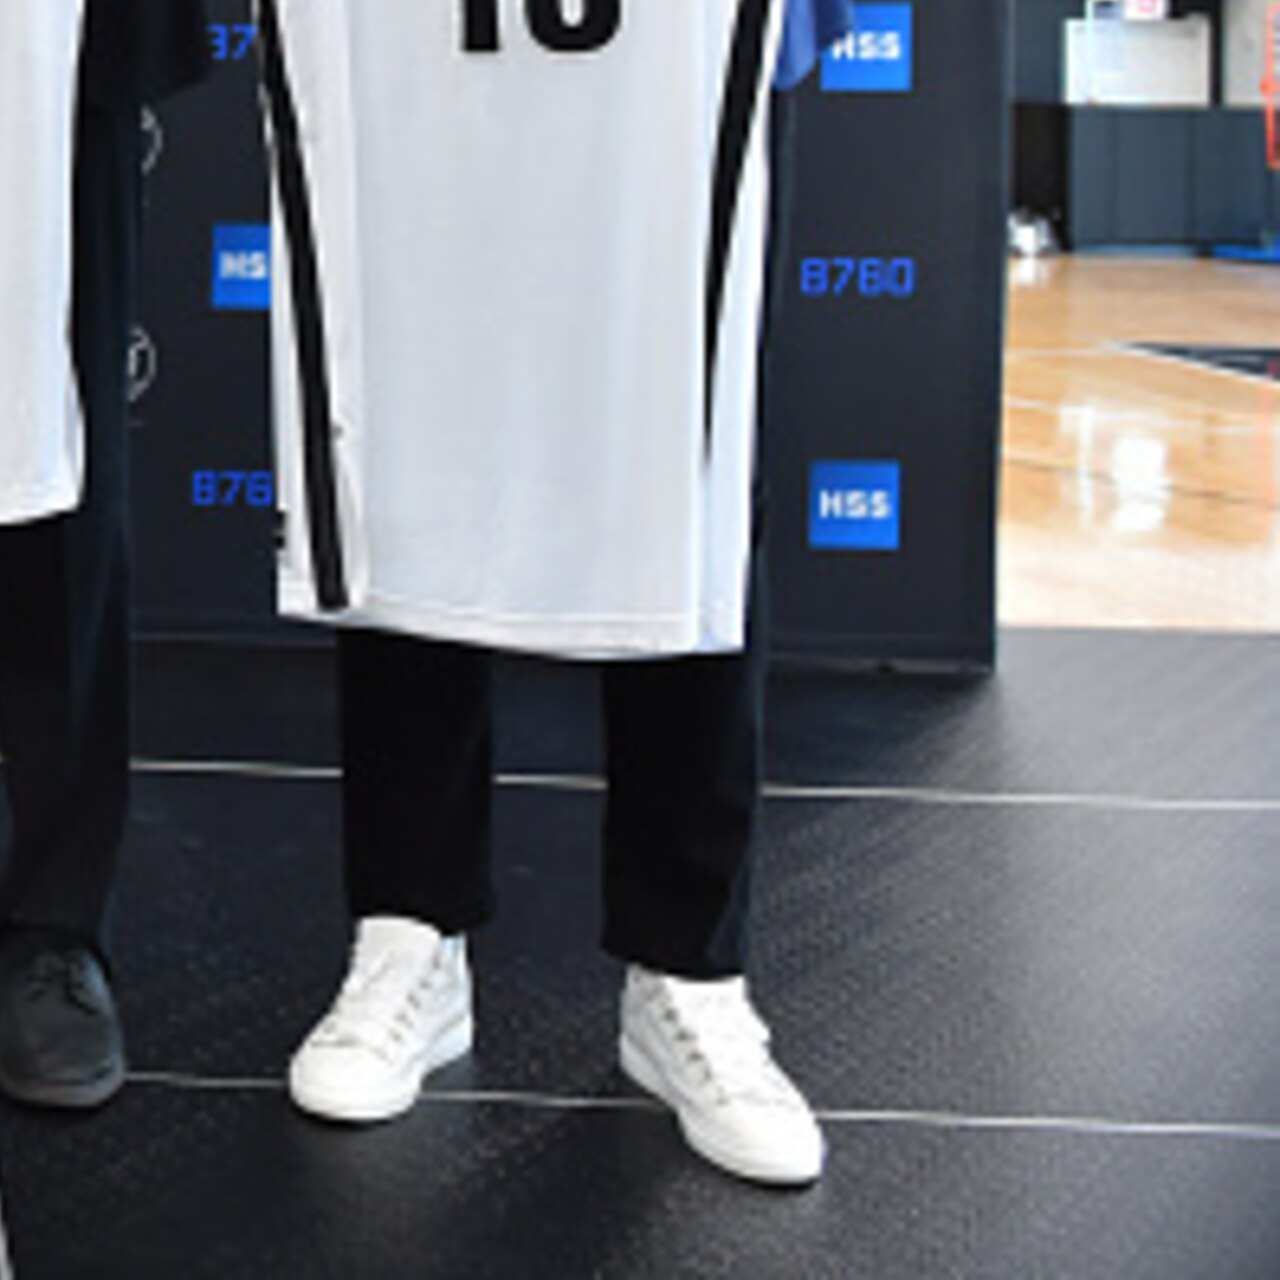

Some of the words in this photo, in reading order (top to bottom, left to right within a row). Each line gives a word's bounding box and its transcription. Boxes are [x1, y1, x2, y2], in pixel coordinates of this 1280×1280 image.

[801, 258, 915, 297] 8760
[192, 470, 273, 506] 876
[820, 490, 891, 518] HSS
